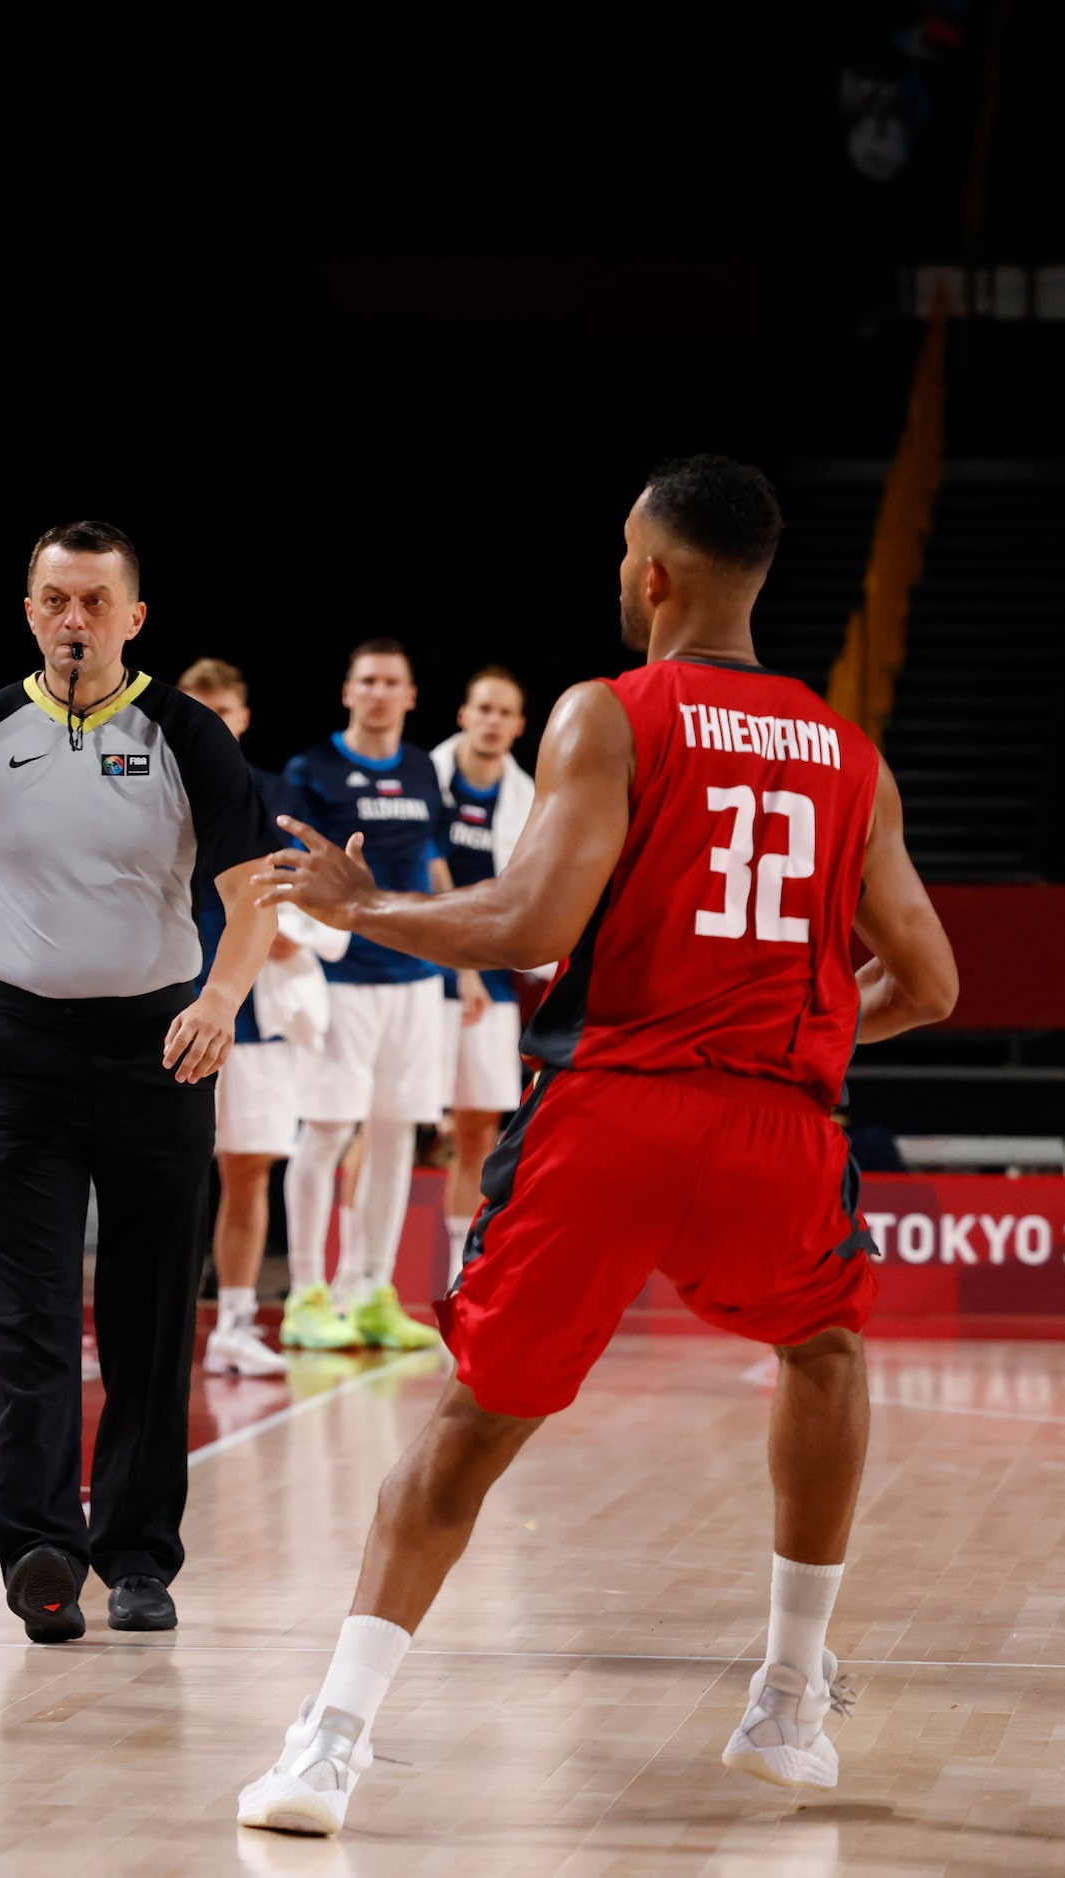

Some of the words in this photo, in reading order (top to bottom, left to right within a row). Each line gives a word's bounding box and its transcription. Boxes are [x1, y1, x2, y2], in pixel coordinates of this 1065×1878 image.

[679, 702, 841, 770] THIEMANN
[695, 784, 816, 943] 32
[864, 1212, 1051, 1266] TOKYO
